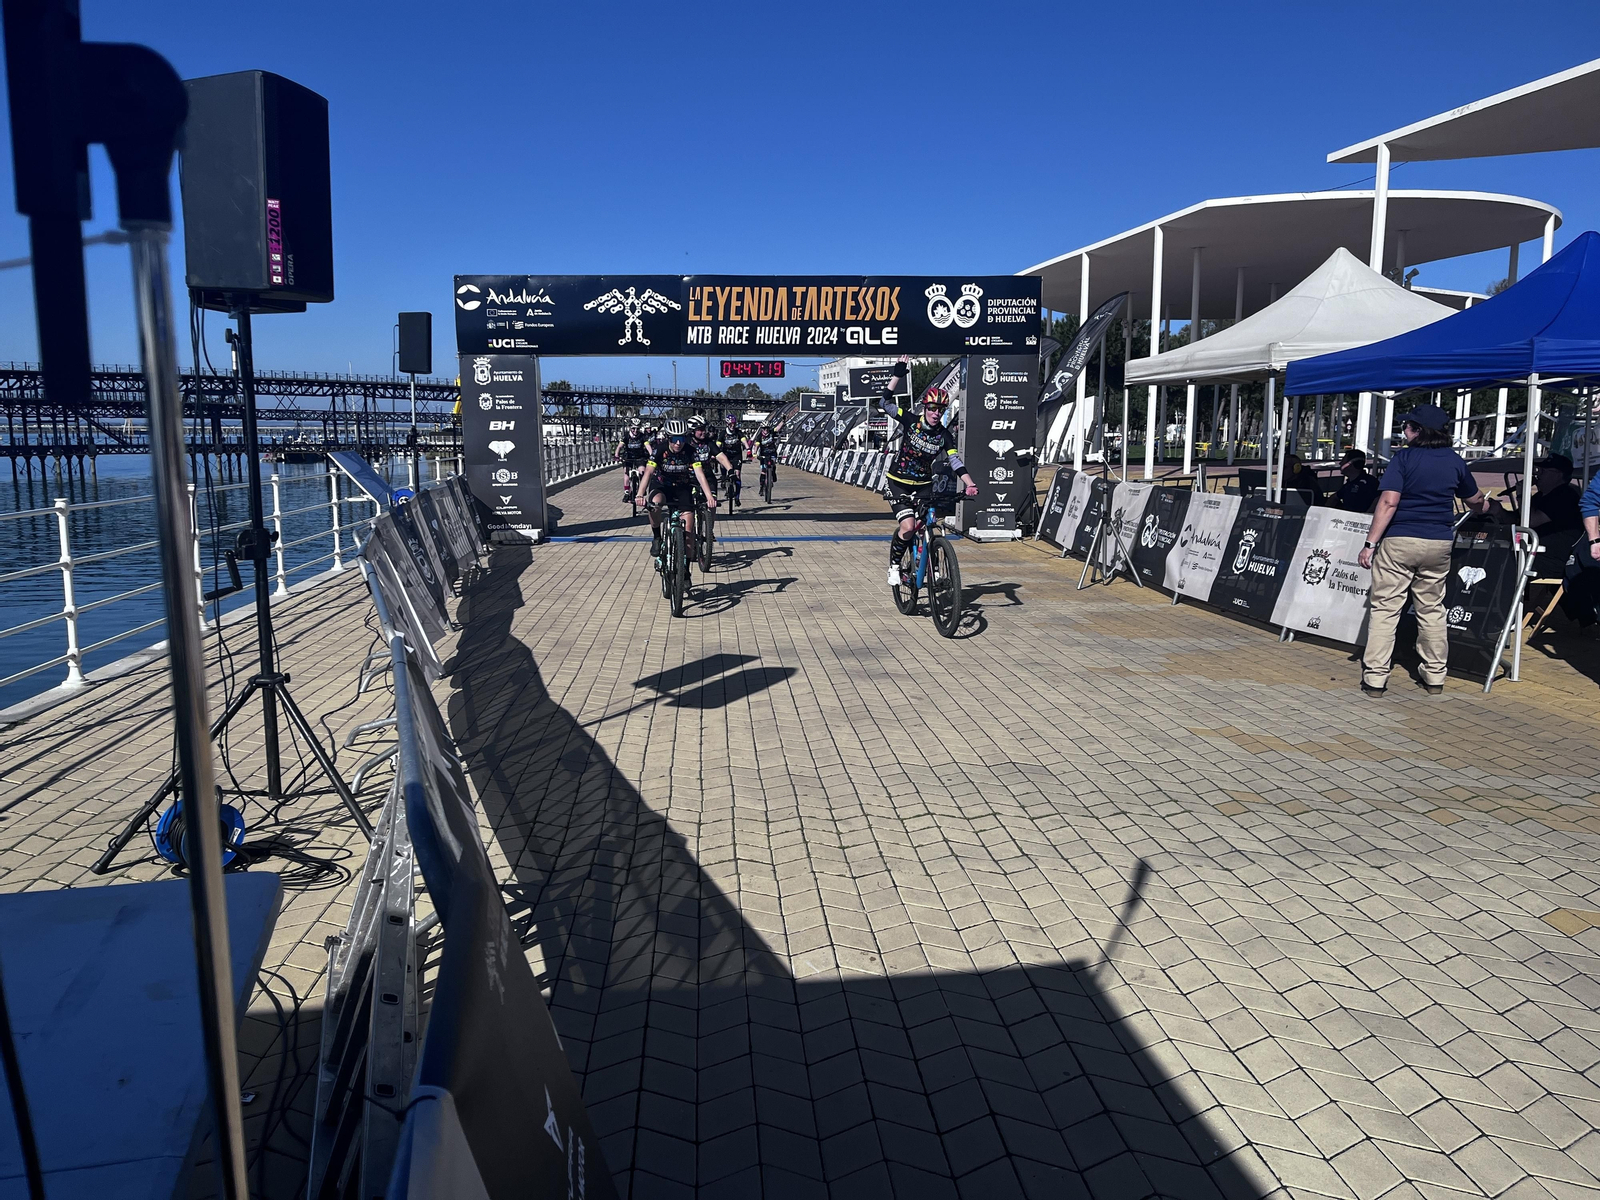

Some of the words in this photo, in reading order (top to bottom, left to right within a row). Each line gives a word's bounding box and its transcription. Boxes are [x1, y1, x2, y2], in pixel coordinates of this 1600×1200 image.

[268, 209, 281, 245] 1200
[486, 288, 555, 305] Andalucía
[690, 287, 700, 300] LA
[688, 287, 787, 321] LEYENDA
[793, 287, 901, 321] TARTESSOS
[987, 297, 1037, 306] DIPUTACIÓN
[791, 307, 802, 320] DE
[687, 326, 712, 344] MTB
[718, 326, 750, 344] RACE
[755, 326, 800, 345] HUELVA
[807, 326, 838, 345] 2024
[970, 337, 990, 346] UCI
[493, 339, 515, 348] UCI
[723, 362, 782, 376] 04:47:19
[489, 420, 515, 430] BH
[991, 420, 1016, 430] BH
[1248, 561, 1276, 576] HUELVA
[1331, 567, 1348, 580] Palos
[1349, 571, 1358, 581] de
[1328, 579, 1335, 590] la
[1337, 580, 1370, 596] Frontera
